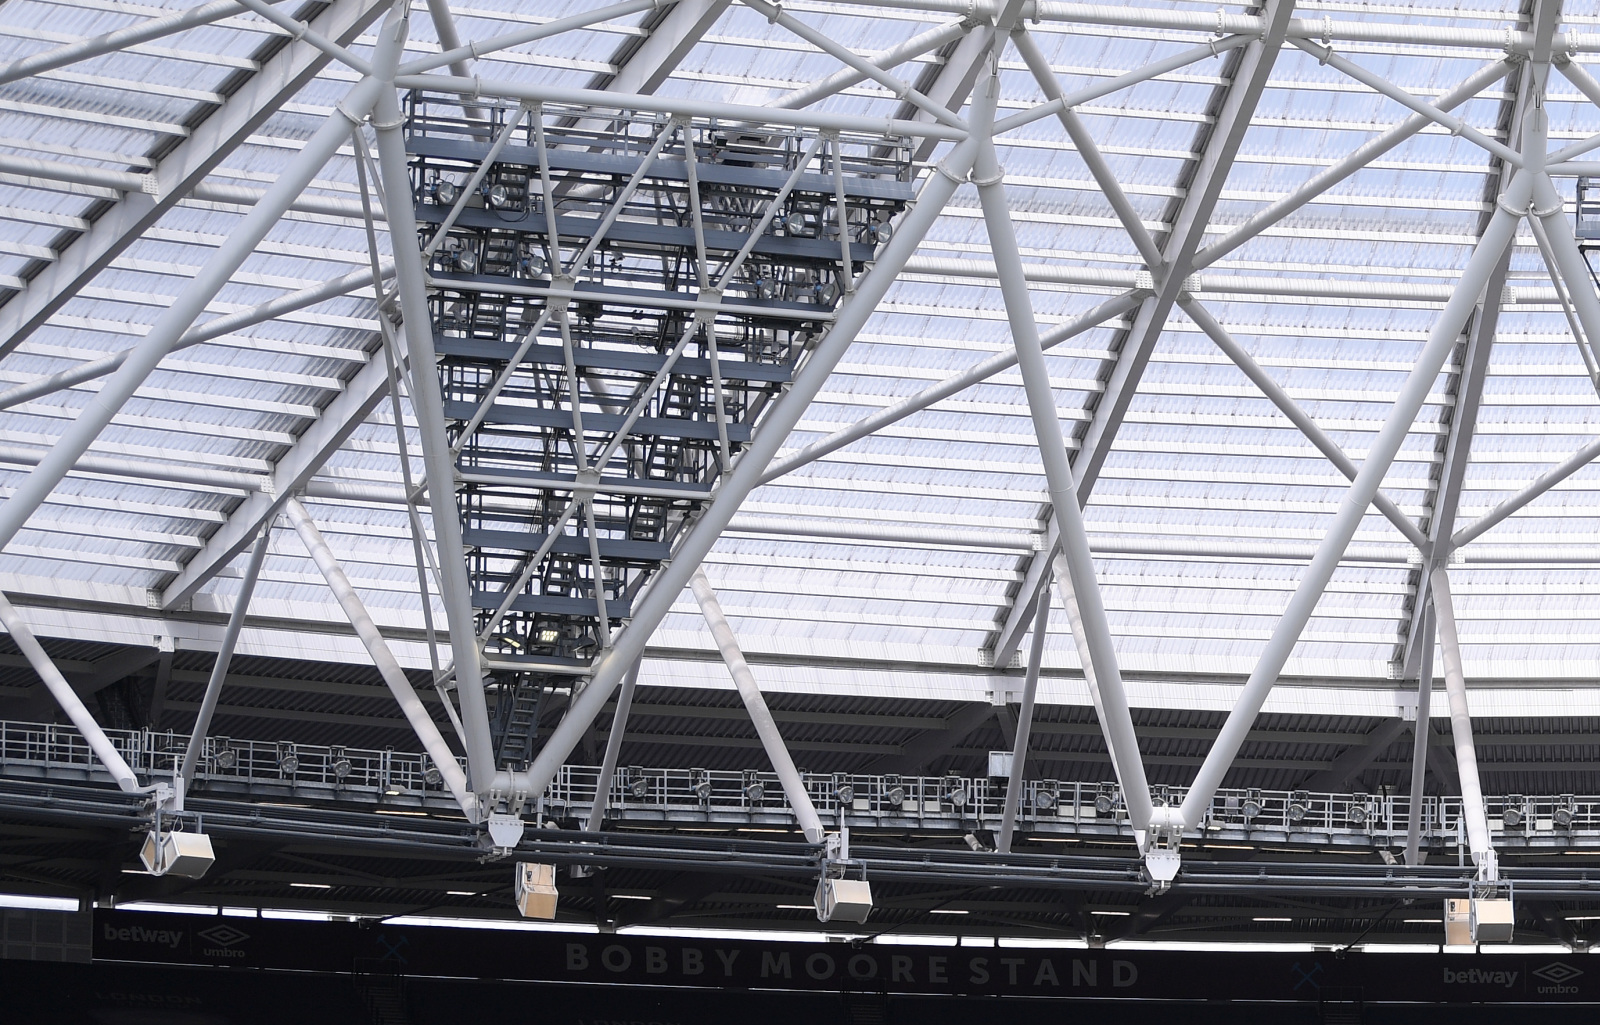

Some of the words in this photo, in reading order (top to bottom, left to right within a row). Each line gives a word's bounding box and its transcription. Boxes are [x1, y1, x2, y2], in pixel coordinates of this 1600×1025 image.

[104, 922, 183, 948] betway
[203, 947, 246, 958] umbro
[566, 943, 742, 977] BOBBY
[759, 950, 949, 984] MOORE
[968, 956, 1139, 988] STAND
[1443, 967, 1519, 988] betway
[1537, 983, 1579, 994] umbro
[95, 991, 203, 1005] LONDON
